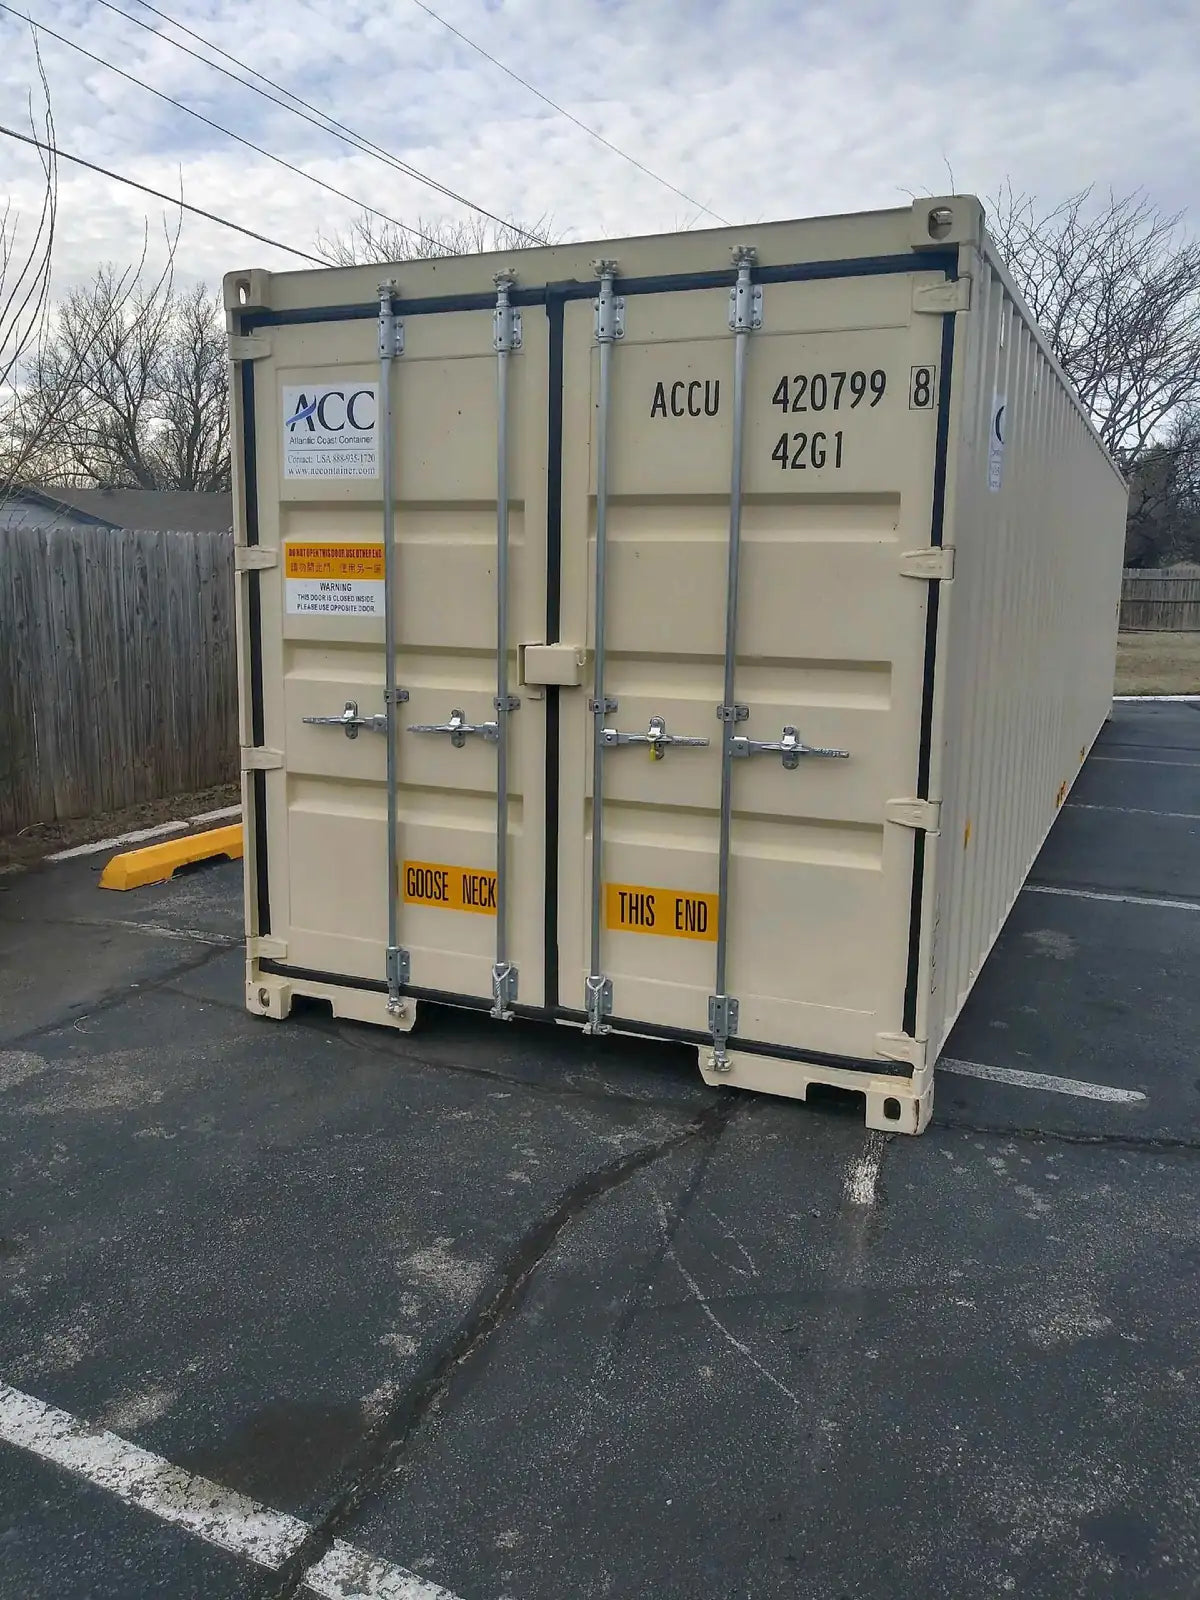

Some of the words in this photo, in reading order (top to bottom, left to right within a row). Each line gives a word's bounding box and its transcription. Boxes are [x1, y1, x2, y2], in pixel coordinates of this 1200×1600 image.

[650, 380, 720, 418] ACCU
[772, 369, 887, 413] 420799
[913, 368, 930, 407] 8
[286, 390, 375, 431] ACC
[289, 436, 315, 445] Atlantic
[316, 435, 337, 445] Coast
[338, 435, 373, 444] Container
[771, 431, 843, 470] 42G1
[316, 454, 332, 463] USA
[297, 593, 309, 601] THIS
[319, 583, 352, 592] WARNING
[297, 603, 318, 611] PLEASE
[330, 604, 357, 612] OPPOSITE
[407, 867, 449, 902] GOOSE
[462, 874, 496, 908] NECK
[618, 891, 655, 927] THIS
[675, 898, 708, 933] END
